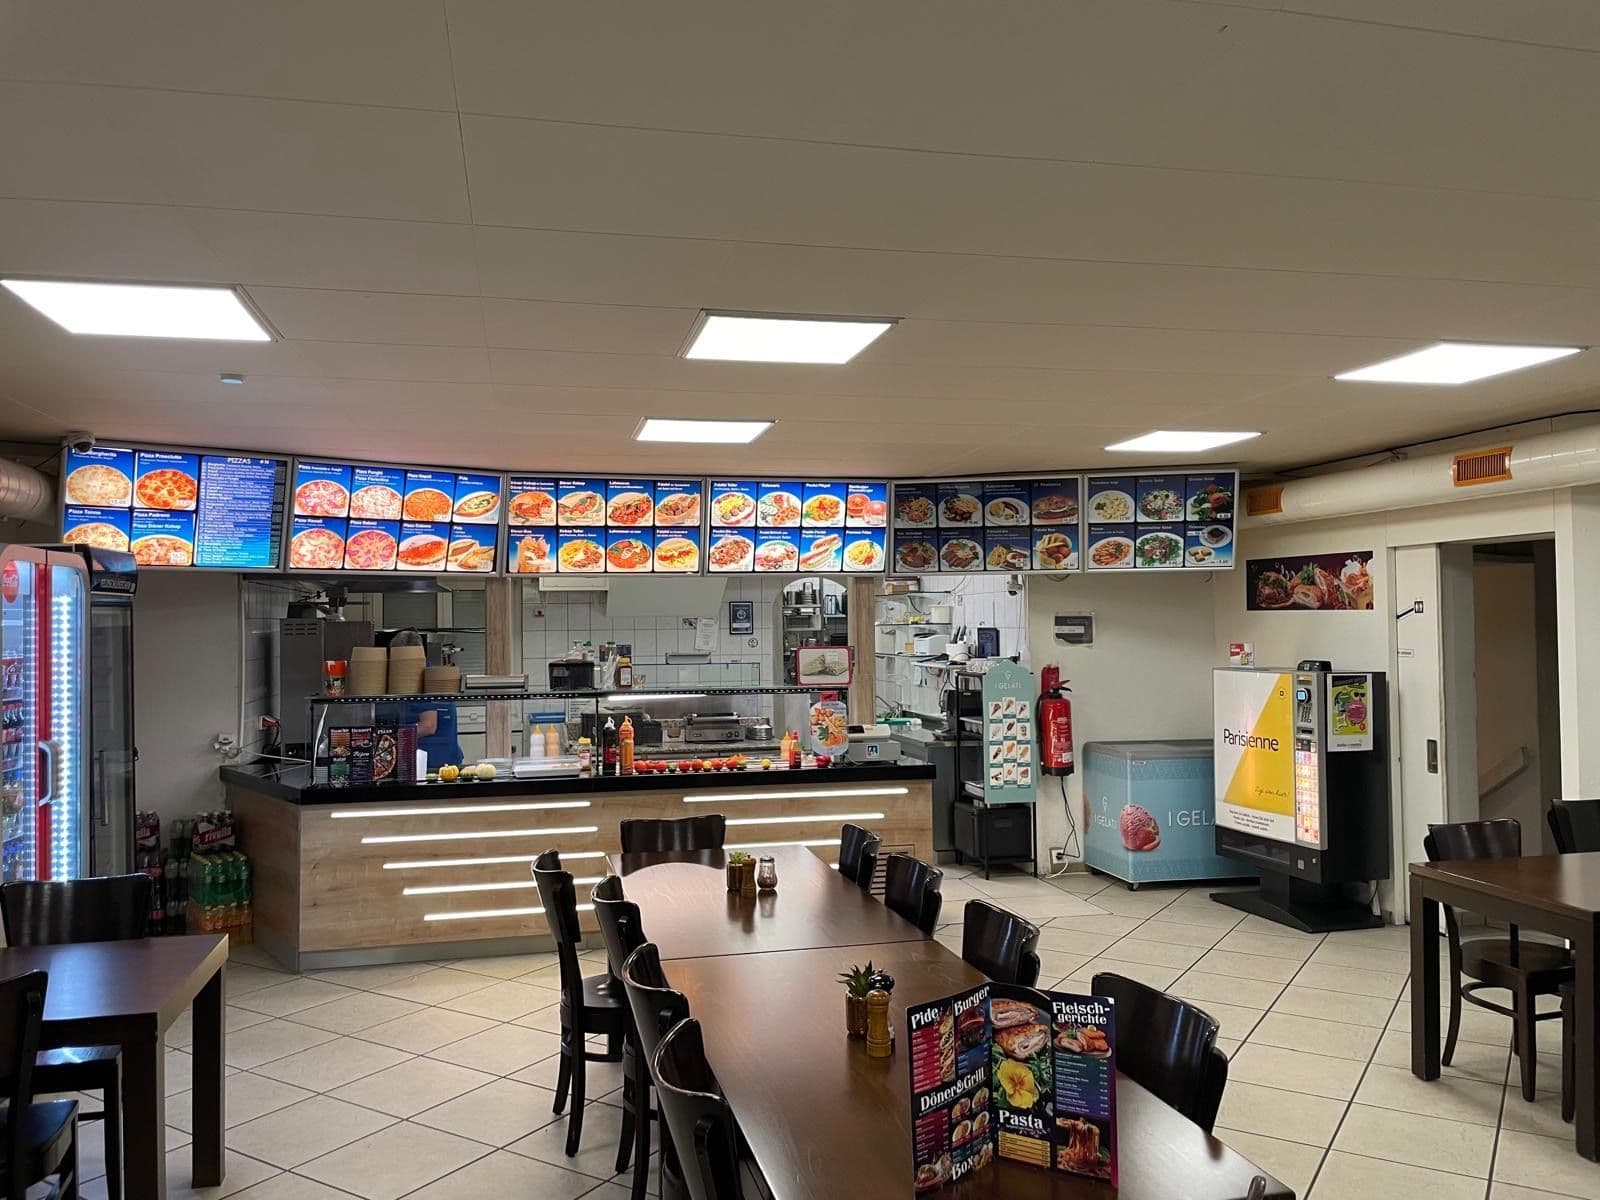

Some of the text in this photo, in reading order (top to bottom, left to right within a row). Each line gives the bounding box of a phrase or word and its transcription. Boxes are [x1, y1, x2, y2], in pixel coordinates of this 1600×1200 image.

[1223, 728, 1279, 752] Parisienne
[954, 985, 990, 1017] Burger
[1052, 1001, 1111, 1015] Fleisch-
[911, 1007, 939, 1030] Pide
[1057, 1013, 1107, 1025] gerichte
[920, 1066, 985, 1112] Döner&Grill
[999, 1109, 1044, 1130] Pasta
[951, 1156, 974, 1181] Box
